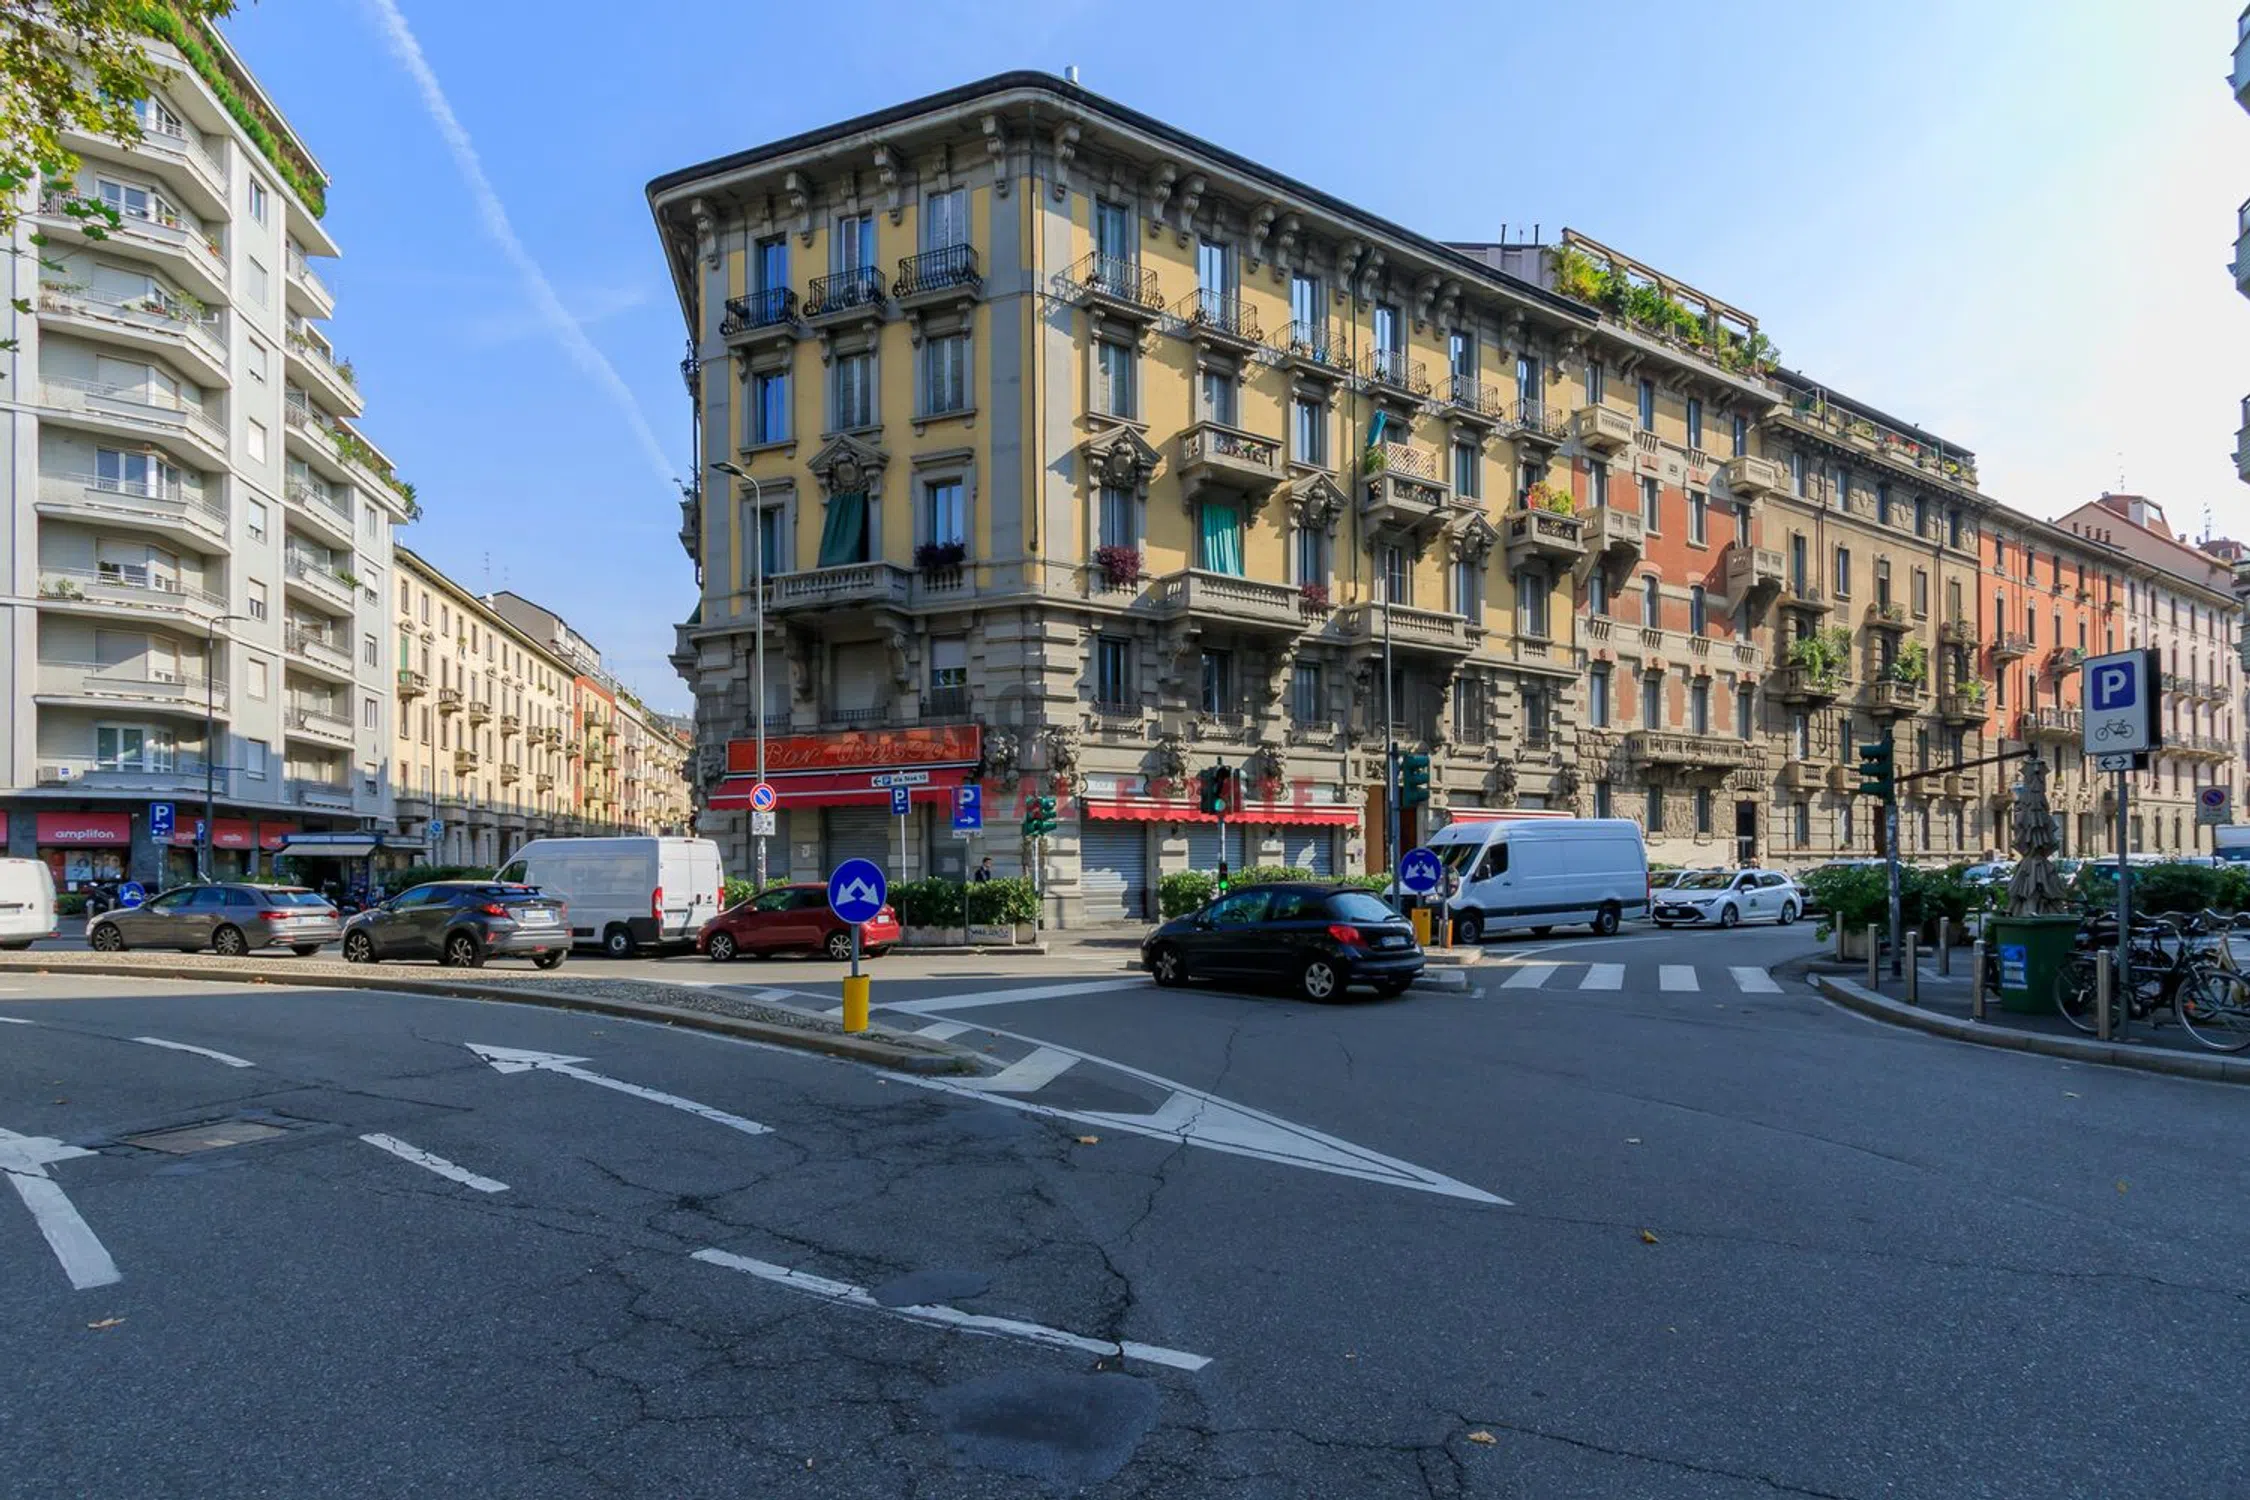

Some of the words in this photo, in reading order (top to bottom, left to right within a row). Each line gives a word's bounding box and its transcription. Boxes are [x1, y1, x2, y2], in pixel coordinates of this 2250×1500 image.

[2102, 669, 2127, 704] P
[895, 790, 905, 804] P
[958, 789, 974, 809] P
[155, 805, 169, 821] P
[55, 829, 115, 841] amplifon
